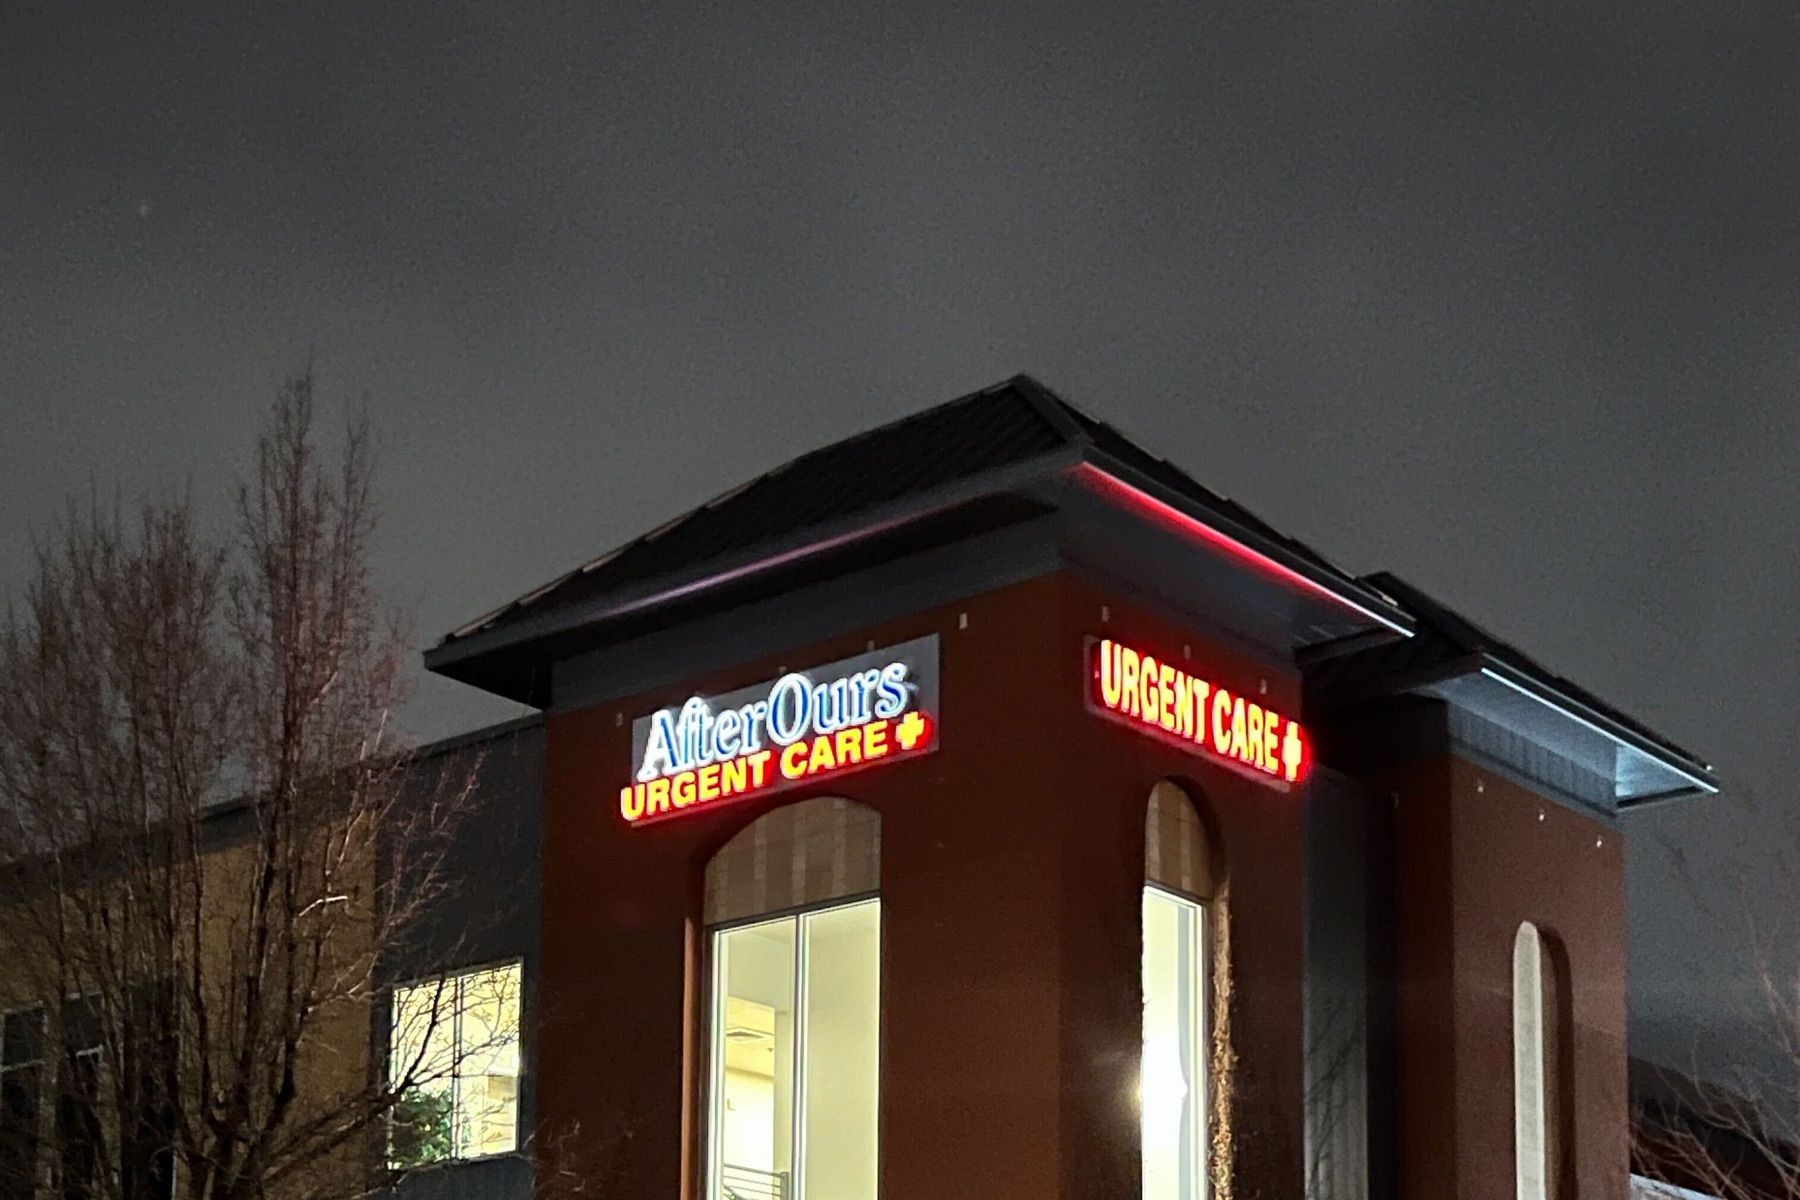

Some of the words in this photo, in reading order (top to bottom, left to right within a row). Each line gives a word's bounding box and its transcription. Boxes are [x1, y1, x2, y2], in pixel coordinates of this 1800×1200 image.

[636, 662, 909, 783] AfterOurs
[1101, 639, 1210, 745] URGENT
[1211, 688, 1279, 775] CARE
[620, 750, 771, 821] URGENT
[780, 720, 888, 780] CARE
